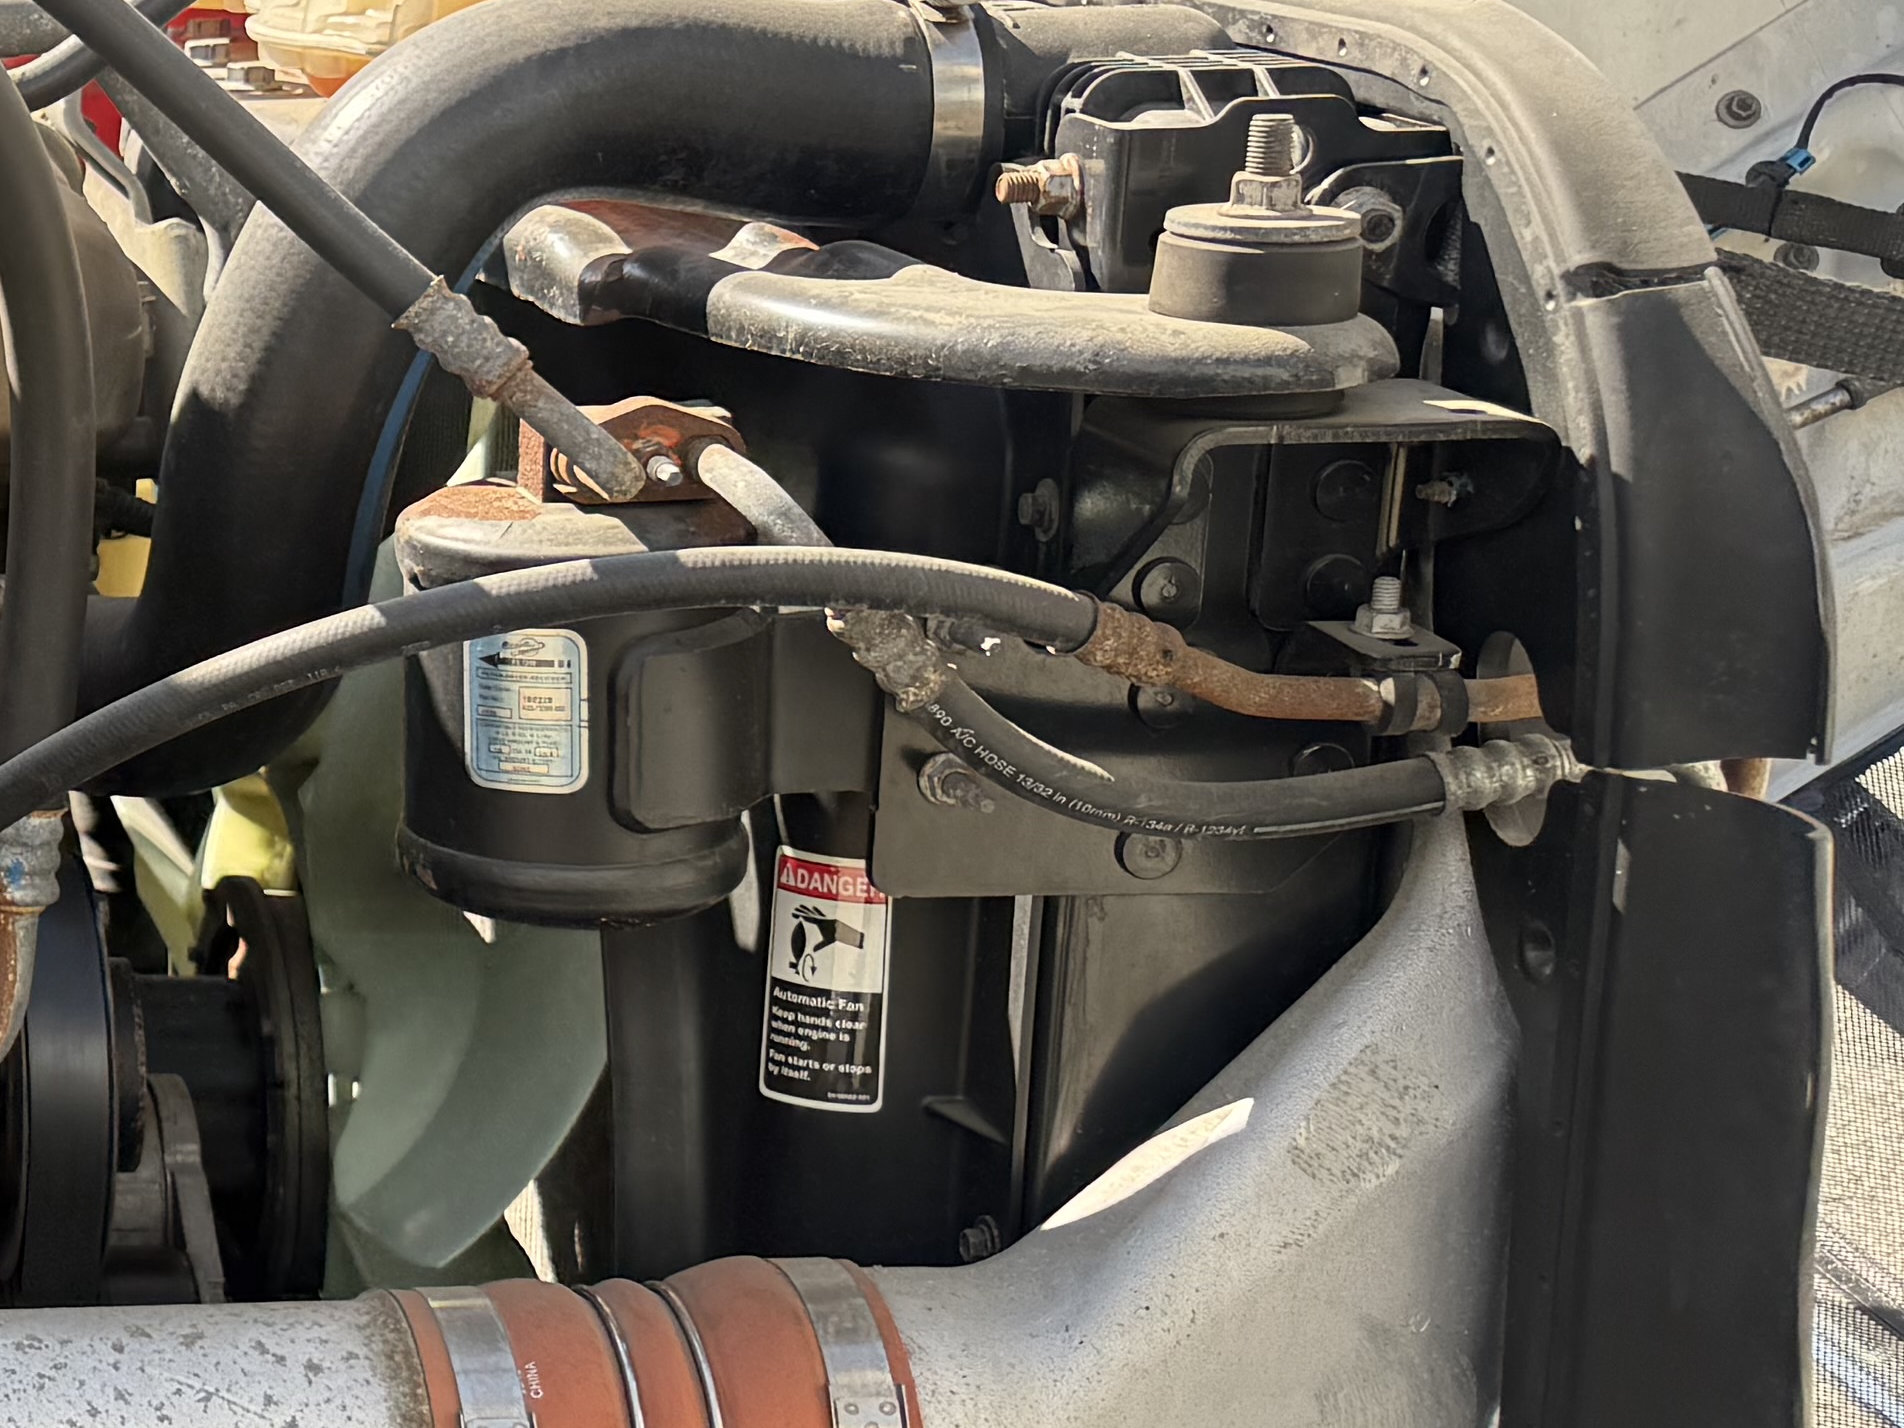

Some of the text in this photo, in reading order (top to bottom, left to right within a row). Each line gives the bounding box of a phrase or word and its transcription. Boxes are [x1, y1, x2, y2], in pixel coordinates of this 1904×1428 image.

[773, 986, 866, 1012] Automatic Fan
[772, 1005, 868, 1031] Keep hands clear
[769, 1032, 812, 1052] running.
[771, 1019, 851, 1043] when engine is
[767, 1062, 812, 1082] by itself.
[769, 1048, 873, 1076] Fan starts or stops
